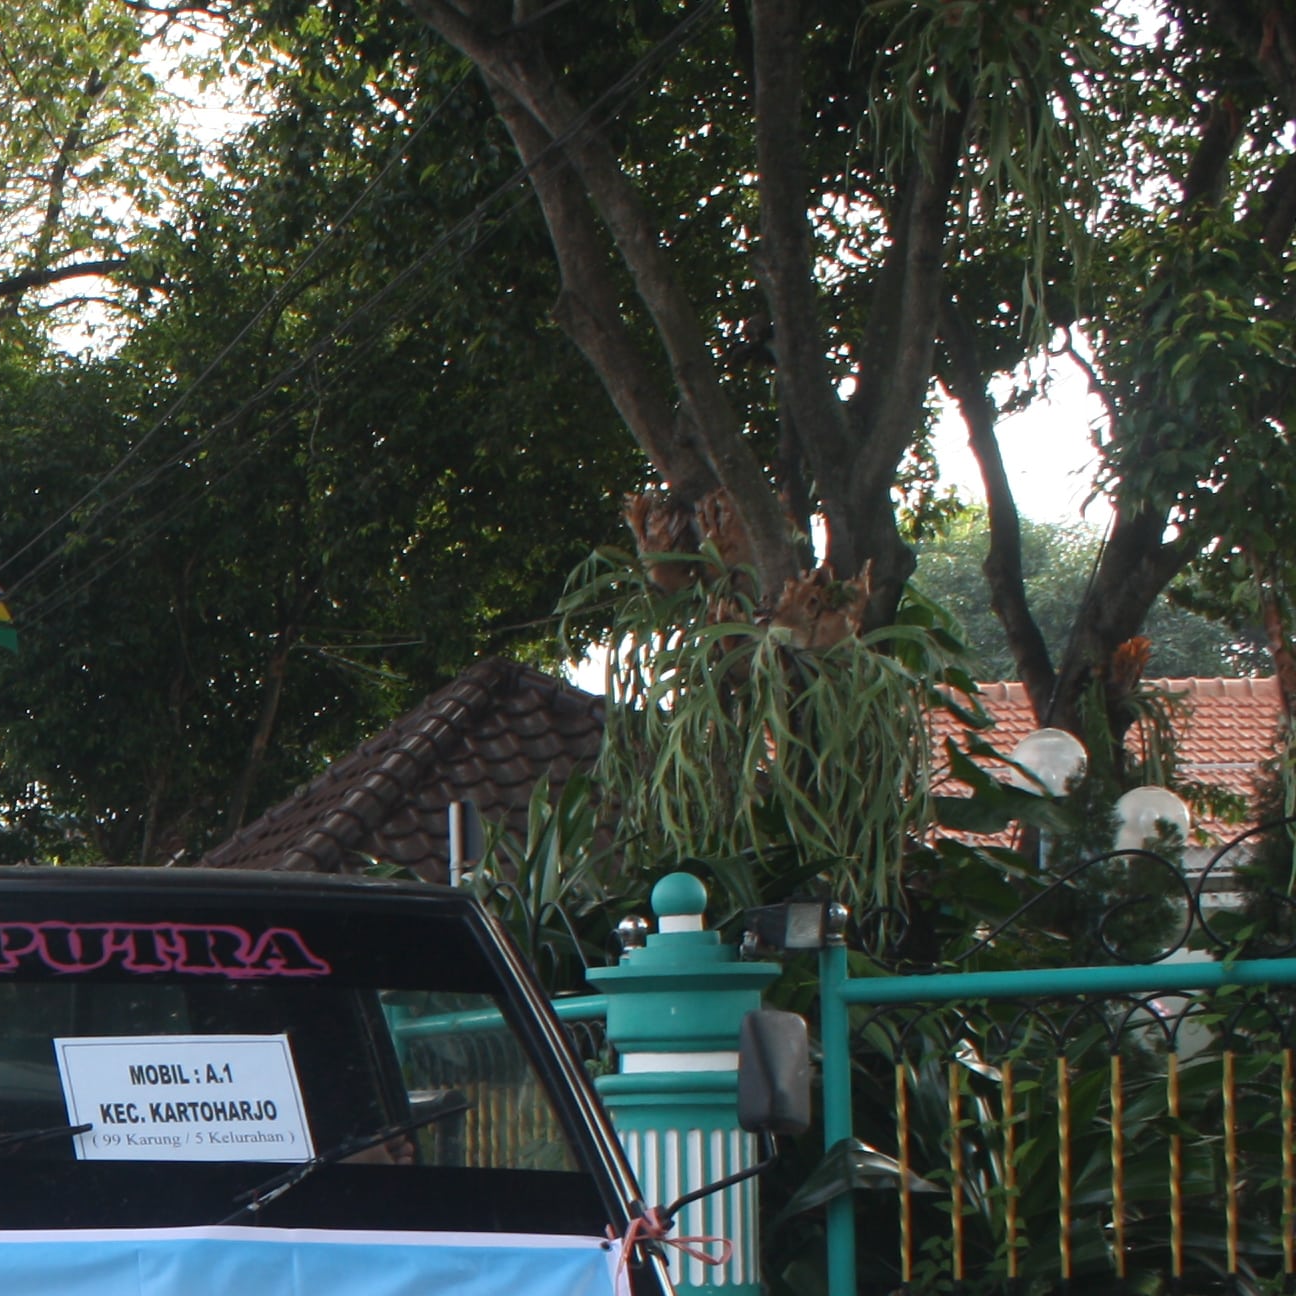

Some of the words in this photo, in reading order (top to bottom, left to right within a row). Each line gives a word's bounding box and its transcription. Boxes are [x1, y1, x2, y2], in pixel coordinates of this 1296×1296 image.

[128, 1064, 190, 1086] MOBIL
[206, 1063, 234, 1084] A.1
[99, 1103, 146, 1125] KEC.
[149, 1100, 278, 1124] KARTOHARJO
[102, 1134, 121, 1146] 99
[126, 1133, 182, 1148] Karung
[195, 1132, 204, 1145] 5
[208, 1130, 285, 1145] Kelurahan
